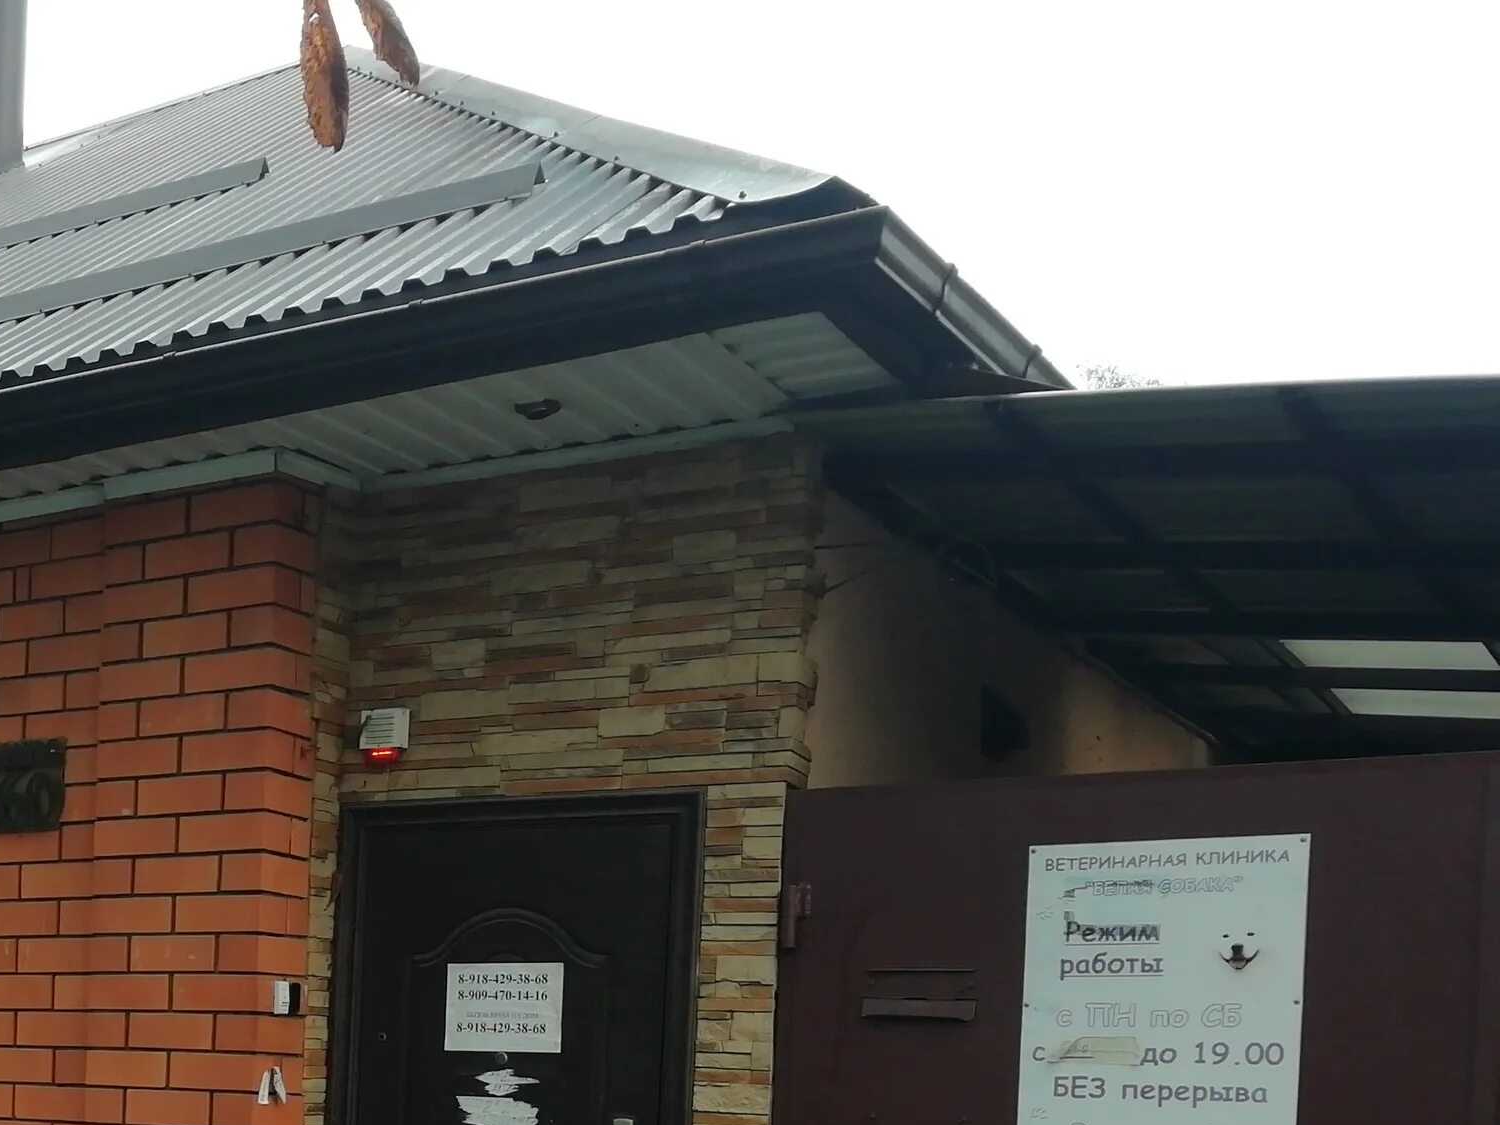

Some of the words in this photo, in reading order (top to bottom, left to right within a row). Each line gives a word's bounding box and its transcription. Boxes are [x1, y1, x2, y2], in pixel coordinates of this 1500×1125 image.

[1045, 853, 1187, 872] ВЕТЕРИНАРНАЯ
[1195, 849, 1290, 866] КЛИНИКА
[1065, 920, 1161, 942] Режим
[1059, 952, 1164, 981] работы
[457, 973, 549, 985] 8-918-429-38-68
[457, 990, 548, 1001] 8-909-470-14-16
[1055, 1007, 1073, 1028] с
[1085, 1002, 1137, 1028] ПН
[1149, 1009, 1189, 1028] по
[1201, 1003, 1243, 1028] СБ
[456, 1022, 546, 1034] 8-918-429-38-68
[1032, 1044, 1046, 1062] с
[1140, 1046, 1178, 1067] до
[1193, 1041, 1285, 1066] 19.00
[1053, 1076, 1106, 1099] БЕЗ
[1121, 1083, 1269, 1108] перерыва
